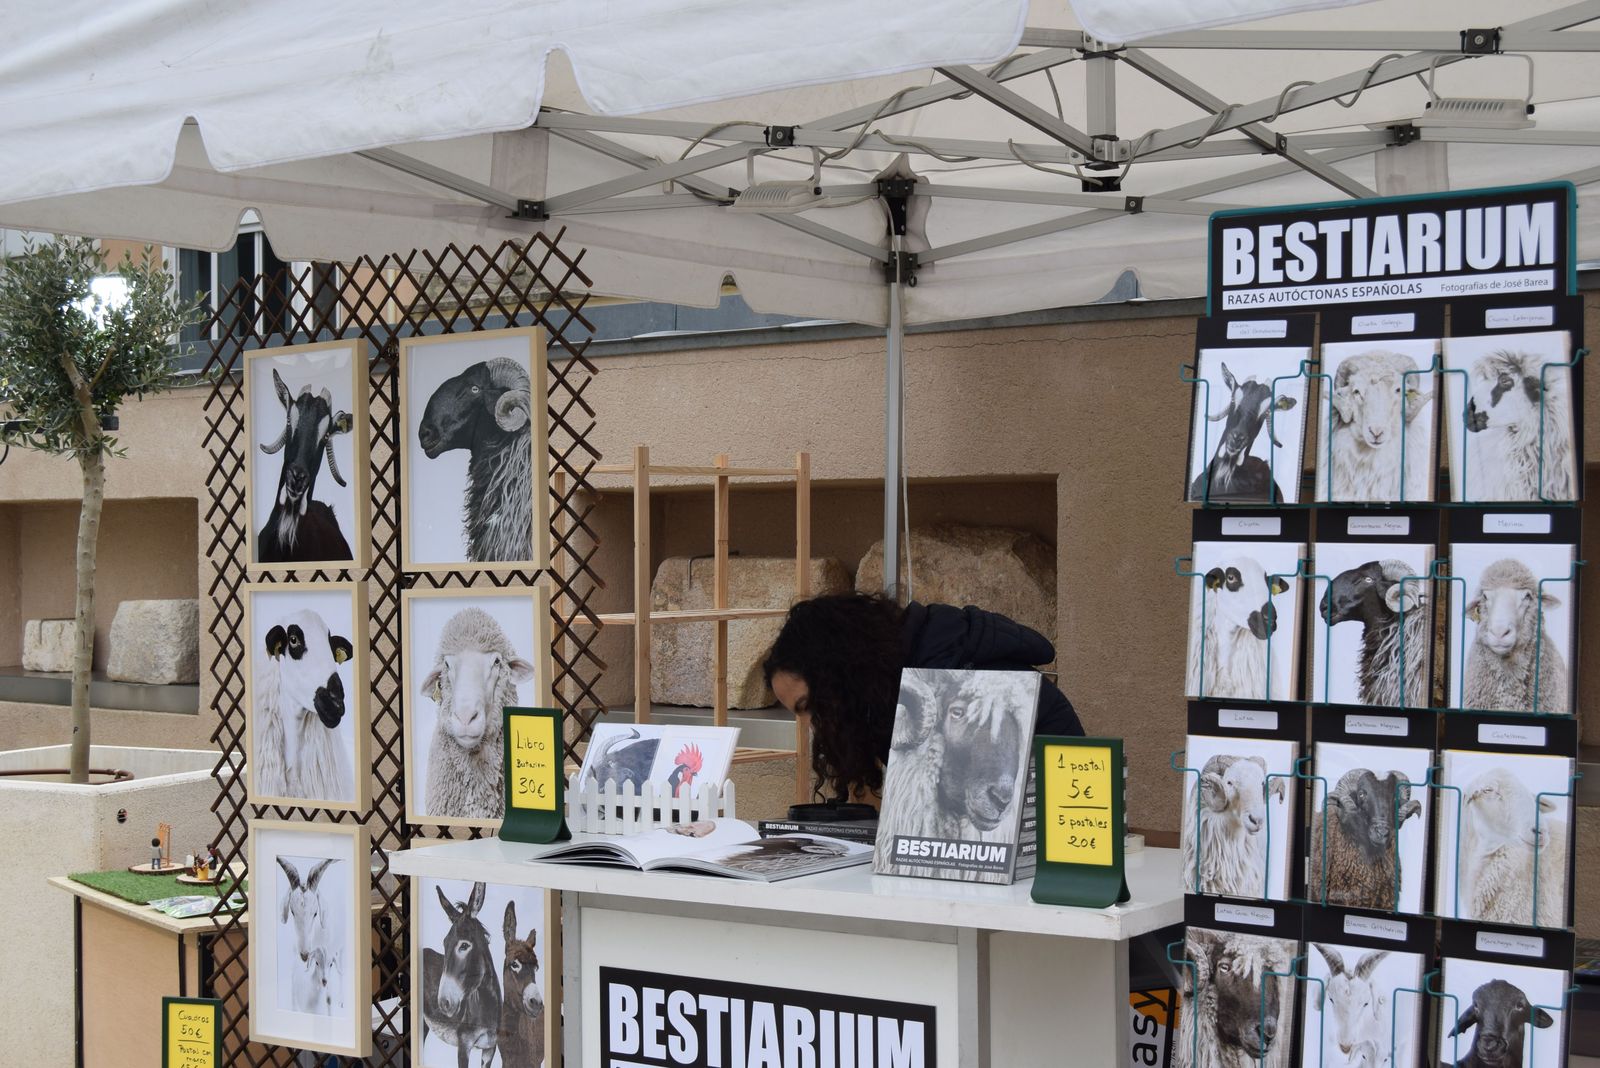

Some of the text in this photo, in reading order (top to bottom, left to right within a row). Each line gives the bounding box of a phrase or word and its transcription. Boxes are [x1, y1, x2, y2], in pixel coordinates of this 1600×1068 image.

[1223, 202, 1555, 286] BESTIARIUM
[1227, 282, 1422, 305] RAZAS AUTÓCTONAS ESPAÑOLAS
[1490, 280, 1501, 290] de
[1503, 278, 1522, 289] José
[1524, 278, 1549, 288] Barea
[517, 729, 545, 751] Libro
[1057, 752, 1105, 772] 1 postal
[518, 777, 546, 798] 30€
[1067, 779, 1094, 799] 5€
[765, 823, 799, 831] BESTIARIUM
[1058, 814, 1108, 829] 5 postales
[897, 839, 1007, 863] BESTIARIUM
[1068, 835, 1096, 849] 20€
[178, 1010, 209, 1024] Cuadros
[608, 982, 925, 1068] BESTIARIUM
[181, 1024, 203, 1039] 50€
